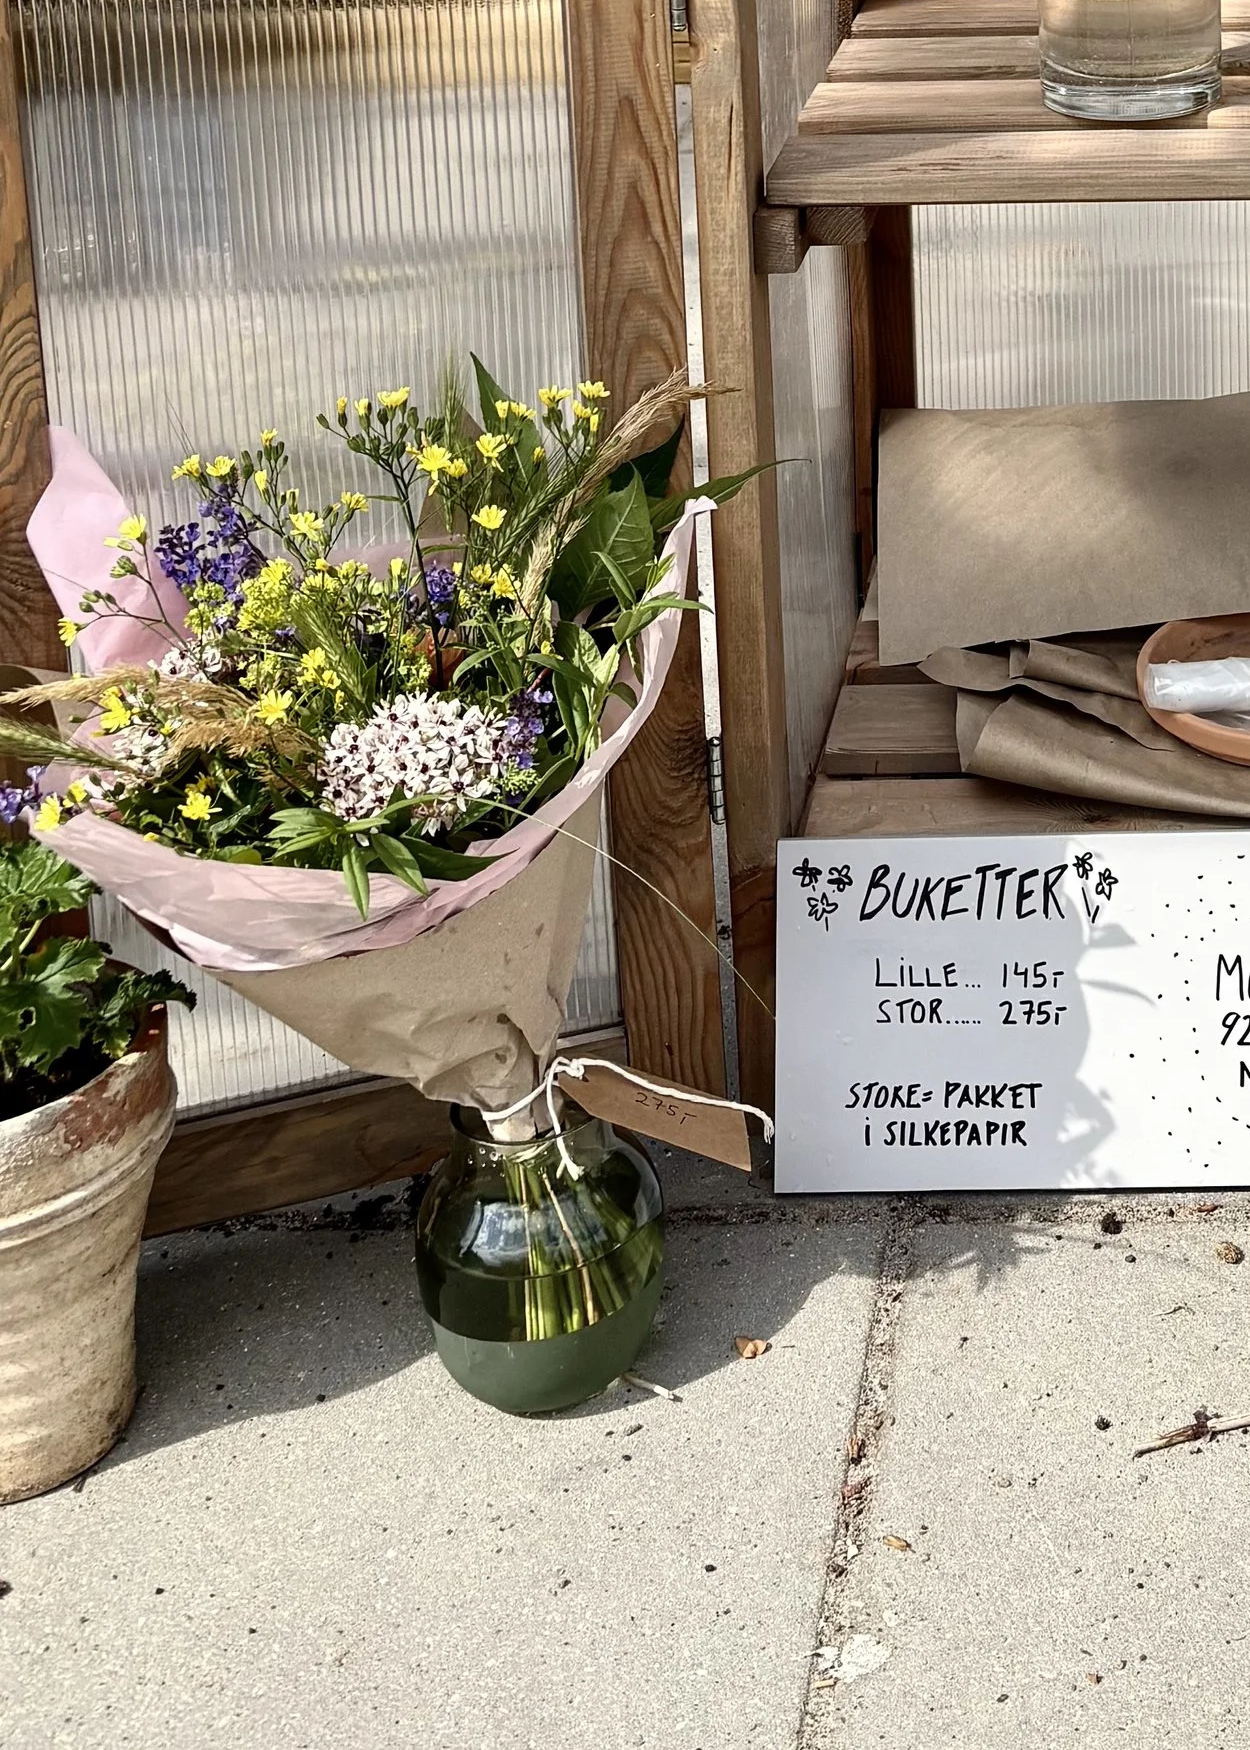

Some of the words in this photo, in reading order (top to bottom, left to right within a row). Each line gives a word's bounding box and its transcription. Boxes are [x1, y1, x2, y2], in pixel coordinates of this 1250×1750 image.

[859, 863, 1069, 922] BUKETTER
[943, 1080, 1043, 1110] PAKKET
[883, 1119, 1029, 1147] SILKEPAPIR
